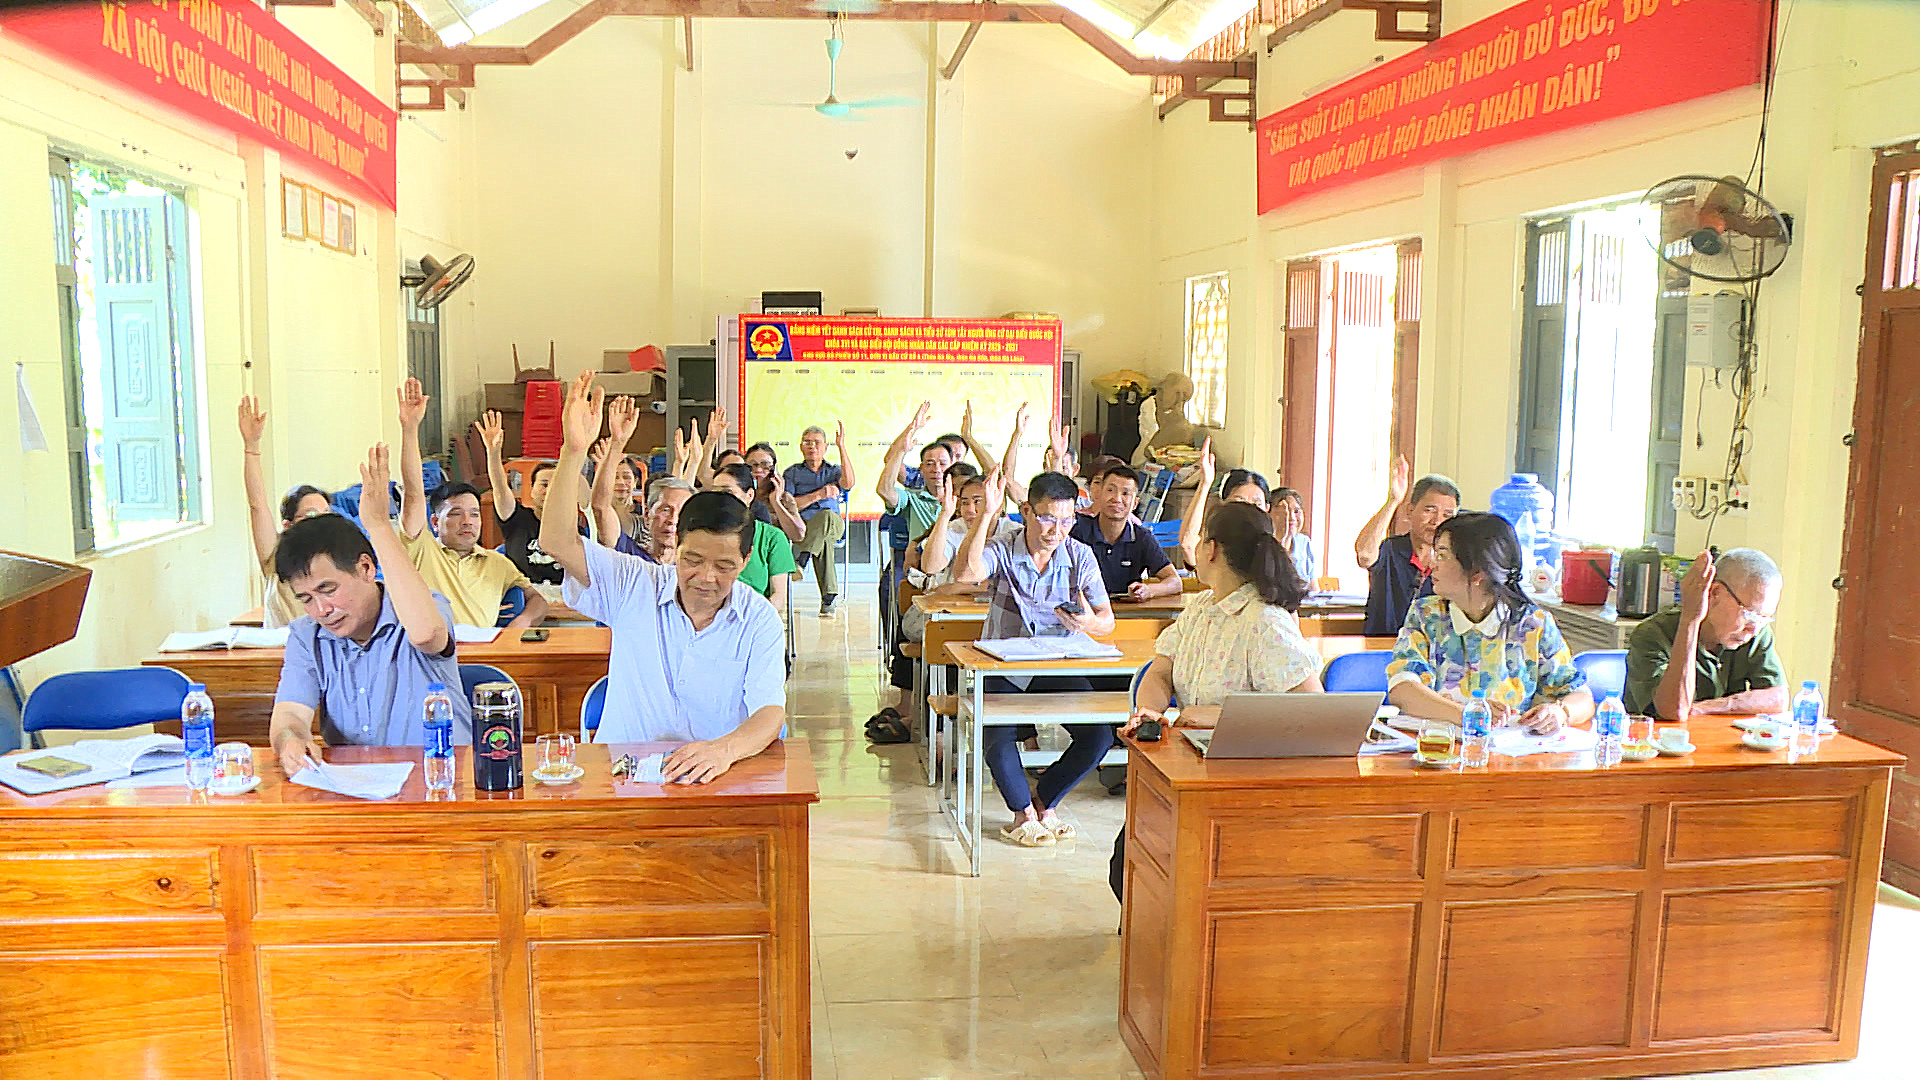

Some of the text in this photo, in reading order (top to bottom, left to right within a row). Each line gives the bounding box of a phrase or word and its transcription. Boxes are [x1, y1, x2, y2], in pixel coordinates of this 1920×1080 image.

[135, 17, 170, 84] HỘI
[172, 41, 208, 97] CHỦ
[210, 62, 256, 123] NGHĨA
[256, 89, 282, 140] VIỆT
[285, 105, 310, 152] NAM
[225, 11, 253, 64] XÂY
[255, 32, 288, 88] DỰNG
[290, 57, 312, 104] NHÀ
[314, 75, 340, 121] NƯỚC
[1300, 101, 1330, 144] SUỐT
[1330, 97, 1354, 136] LỰA
[1358, 77, 1398, 122] CHỌN
[1399, 58, 1457, 106] NHỮNG
[1458, 25, 1520, 84] NGƯỜI
[1522, 4, 1555, 60] ĐỦ
[1289, 155, 1311, 188] VÀO
[1311, 137, 1345, 184] QUỐC
[1344, 133, 1370, 173] HỘI
[1371, 124, 1391, 162] VÀ
[1392, 115, 1422, 158] HỘI
[1475, 79, 1539, 132] NHÂN
